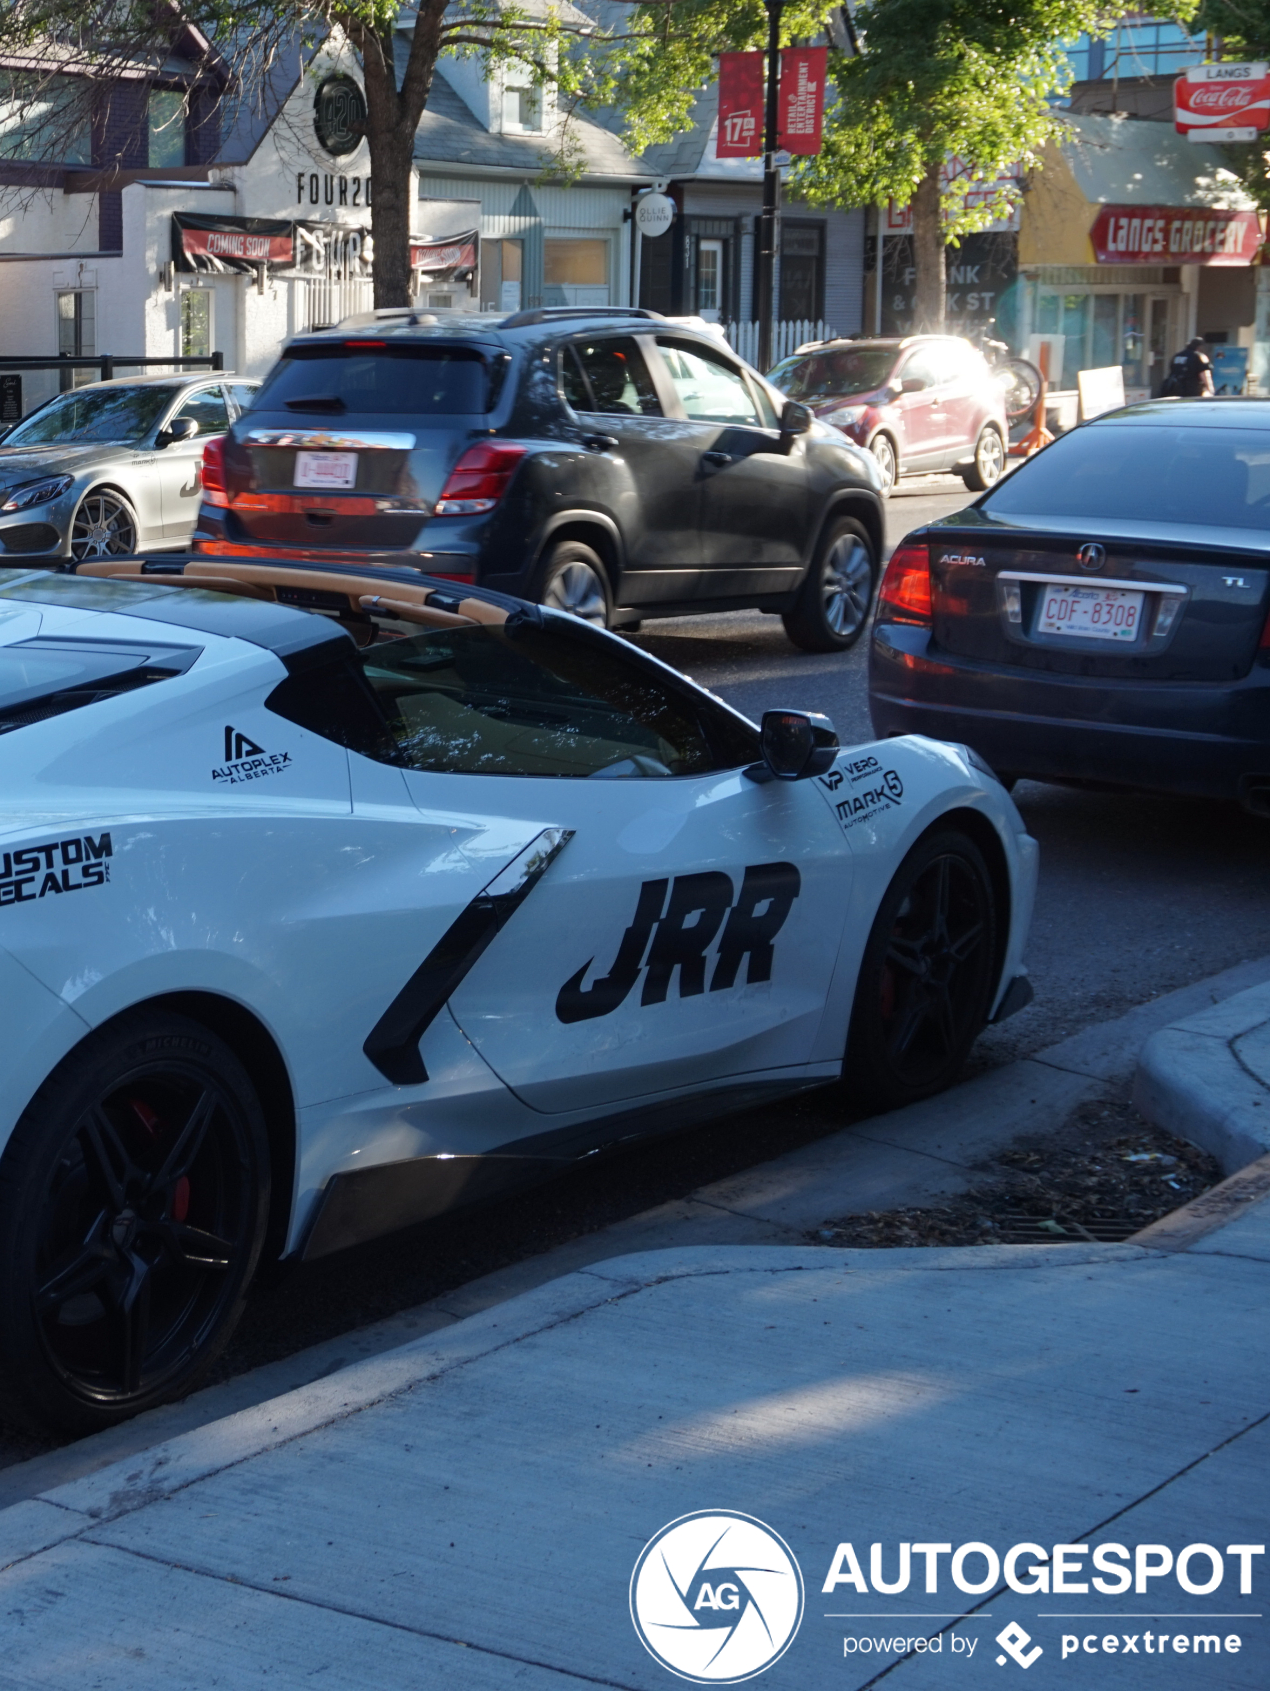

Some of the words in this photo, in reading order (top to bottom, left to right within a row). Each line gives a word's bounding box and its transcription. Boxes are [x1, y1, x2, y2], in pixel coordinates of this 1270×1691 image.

[796, 62, 809, 134] ENTERTAINMENT
[786, 104, 798, 134] RETAIL
[804, 94, 817, 134] DISTRICT
[724, 117, 743, 141] 17
[639, 206, 667, 215] OLLIE
[639, 214, 670, 222] QUINN
[206, 233, 244, 256] COMING
[246, 236, 270, 257] SOON
[1169, 220, 1248, 254] GROCERY
[904, 265, 981, 286] FNK
[940, 554, 986, 566] ACURA
[1221, 576, 1251, 588] TL
[1045, 597, 1137, 628] CDF-8308
[211, 751, 293, 781] AUTOPLEX
[229, 765, 284, 784] ALBERTA
[844, 756, 879, 775] VERO
[851, 766, 883, 783] PERFORMANCE
[843, 803, 892, 830] AUTOMOTIVE
[555, 861, 802, 1025] JRR
